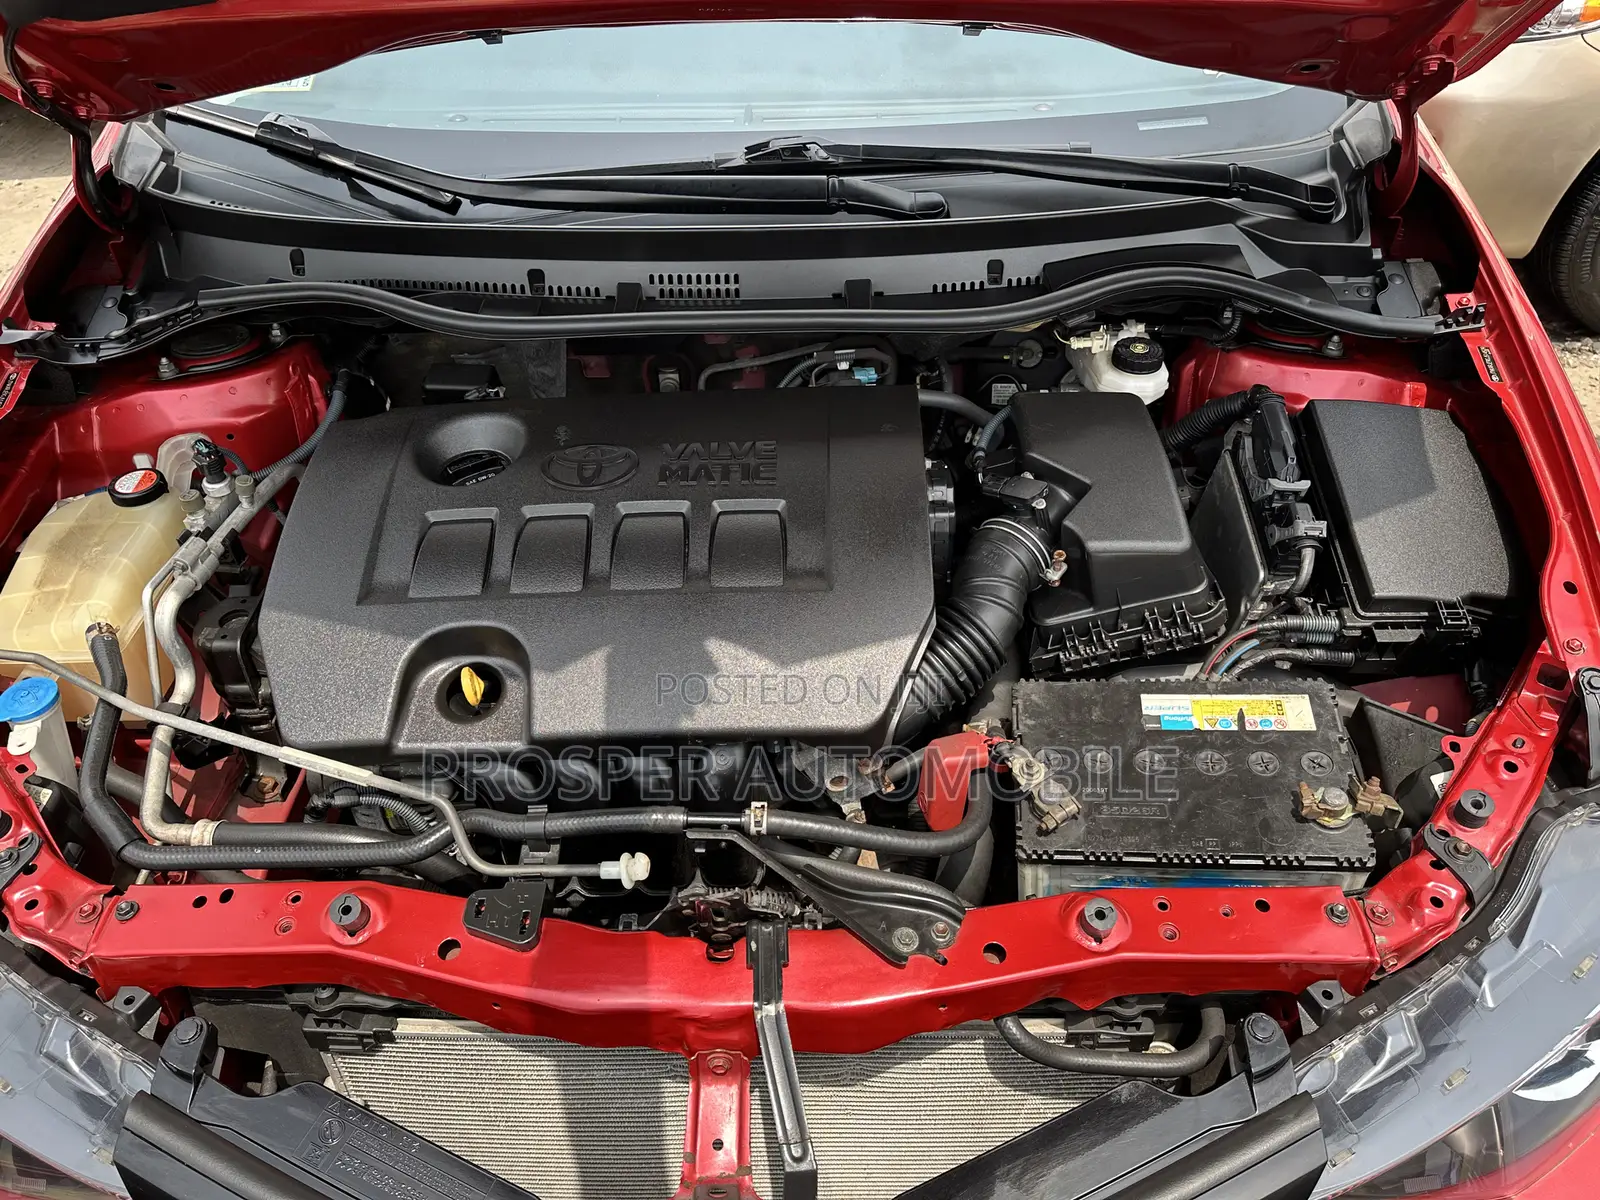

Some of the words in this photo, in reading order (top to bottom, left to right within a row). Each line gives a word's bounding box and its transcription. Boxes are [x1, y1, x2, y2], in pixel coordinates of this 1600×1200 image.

[662, 440, 777, 460] VALVE
[658, 462, 777, 485] MATIC
[344, 1107, 398, 1141] CAUTION
